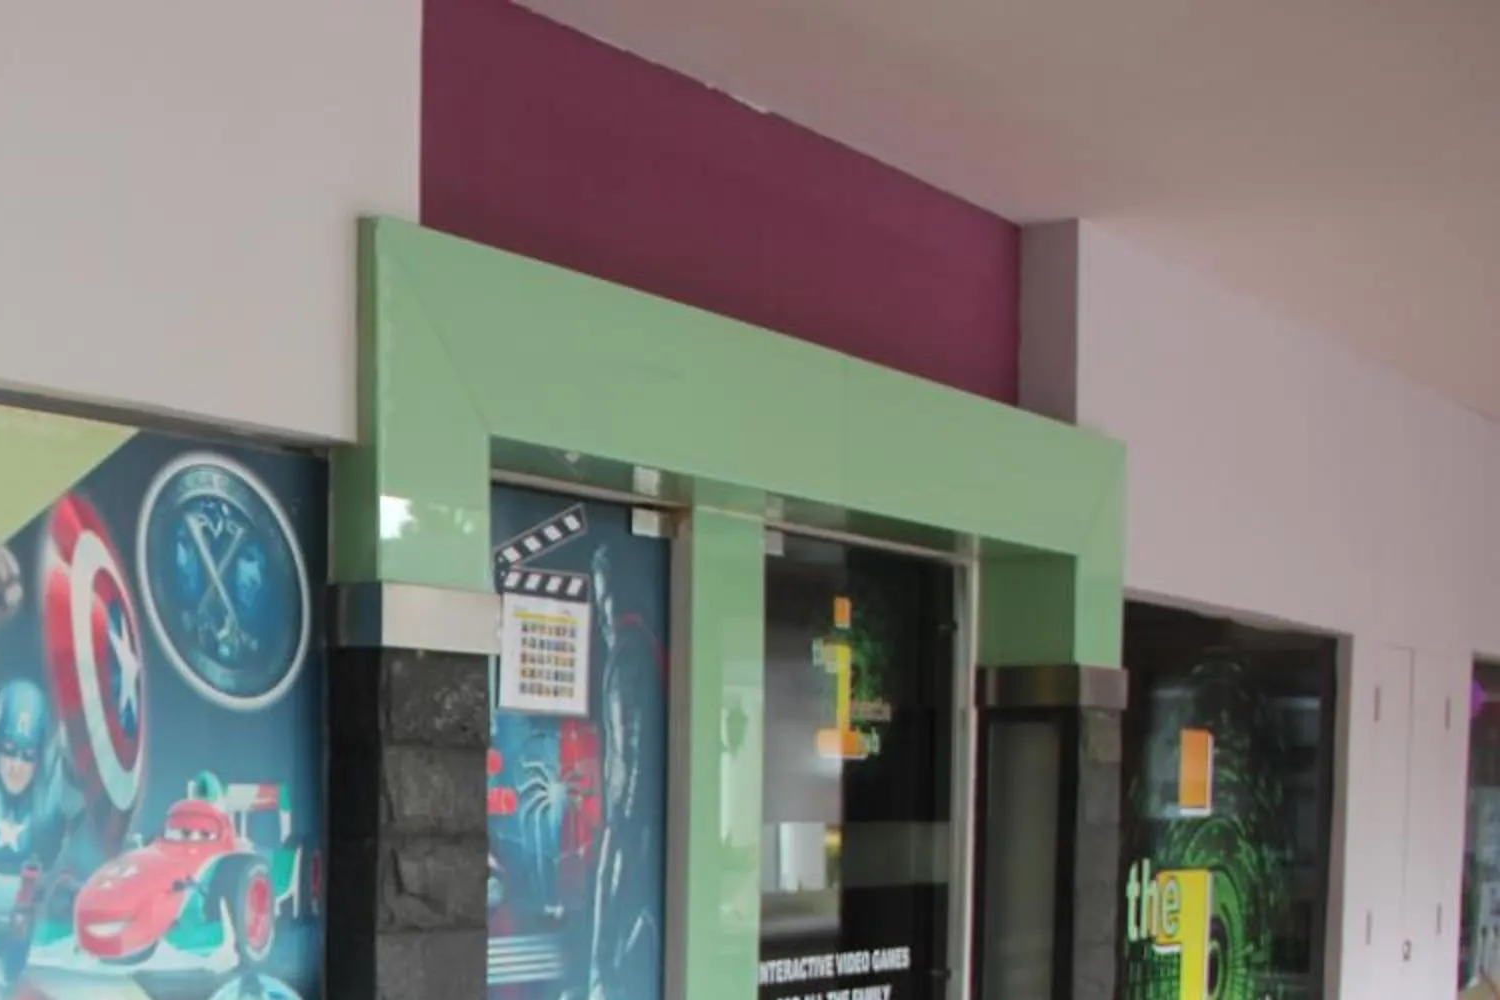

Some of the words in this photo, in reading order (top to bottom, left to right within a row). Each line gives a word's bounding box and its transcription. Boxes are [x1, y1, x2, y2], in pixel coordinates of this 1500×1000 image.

[1126, 857, 1180, 941] the
[835, 951, 870, 976] VIDEO
[871, 946, 911, 973] GAMES
